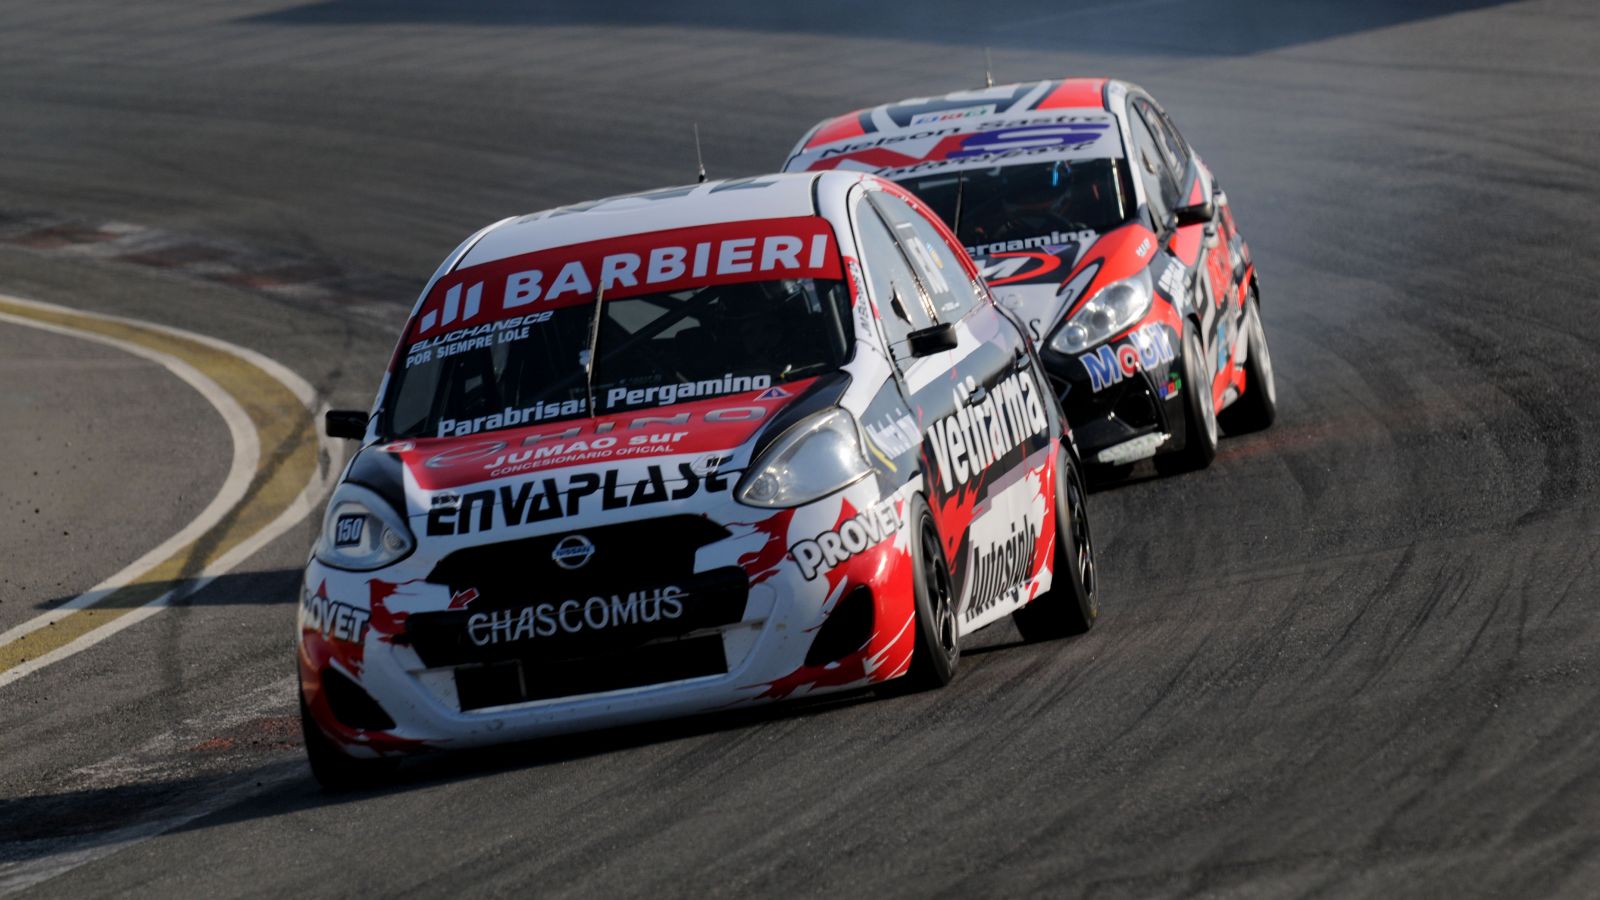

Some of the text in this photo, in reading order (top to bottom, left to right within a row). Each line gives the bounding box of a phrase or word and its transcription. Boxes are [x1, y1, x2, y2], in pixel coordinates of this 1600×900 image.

[820, 126, 961, 158] Nelson
[979, 113, 1108, 133] Sastre
[969, 228, 1101, 257] ergamino
[502, 233, 829, 310] BARBIERI
[405, 326, 531, 369] POR SIEMPRE LOLE
[436, 373, 772, 439] Parabrisas Pergamino
[520, 406, 768, 447] HINO
[483, 431, 689, 470] JUMAO sur
[490, 444, 674, 477] CONCESIONARIO OFICIAL
[337, 517, 361, 543] 150
[555, 542, 591, 557] NISSAN
[467, 585, 684, 647] CHASCOMUS
